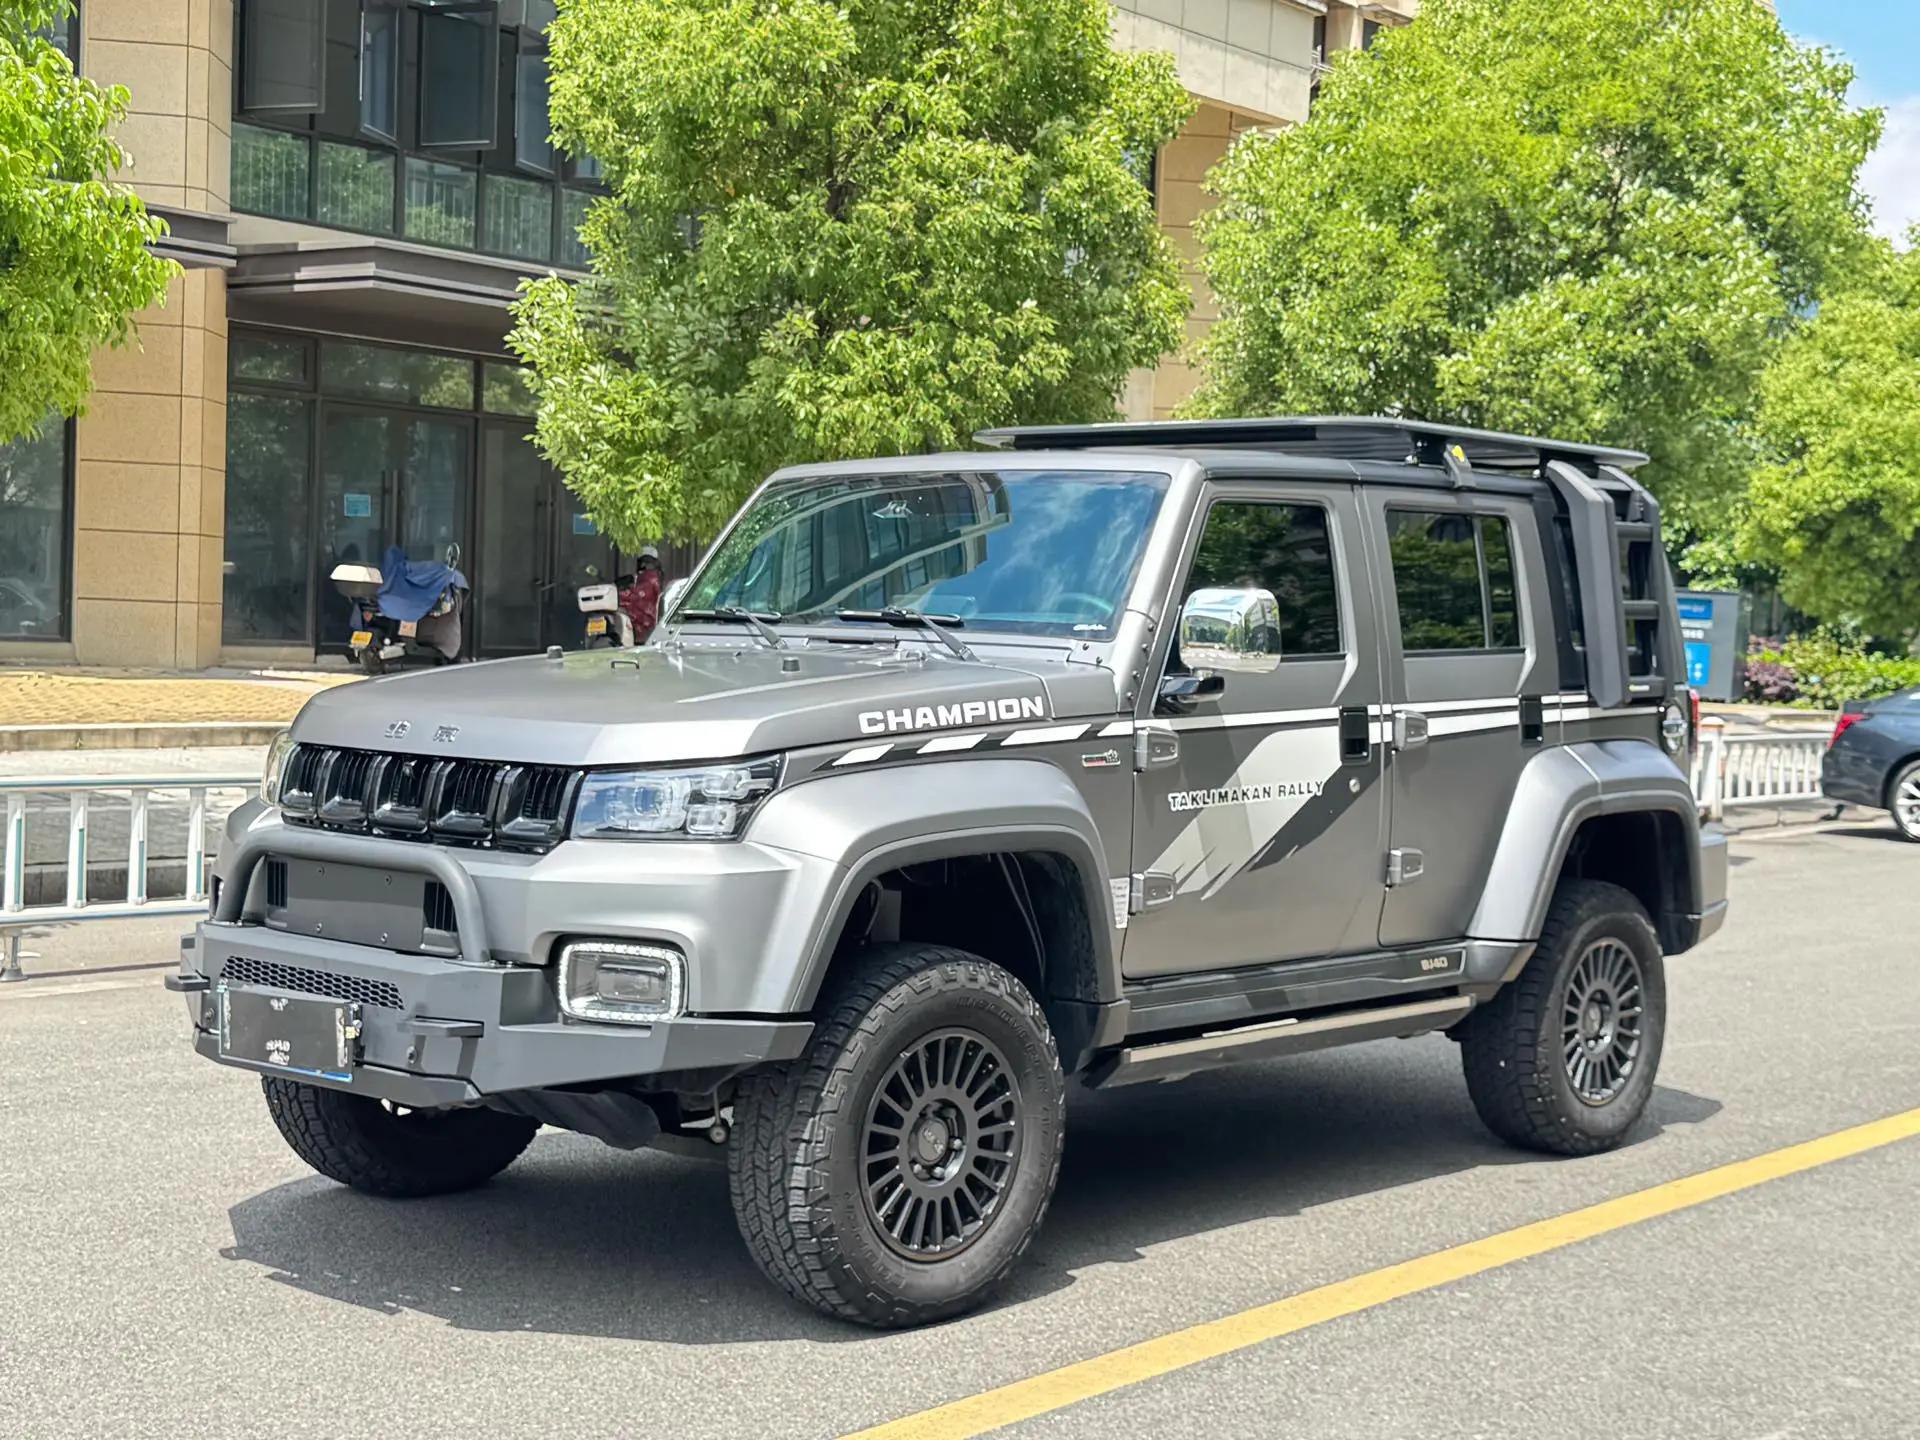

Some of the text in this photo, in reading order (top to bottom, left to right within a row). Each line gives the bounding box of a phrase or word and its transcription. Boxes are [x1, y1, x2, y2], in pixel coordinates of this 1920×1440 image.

[858, 696, 1044, 734] CHAMPION
[1169, 779, 1324, 810] TAKLIMAKAN RALLY
